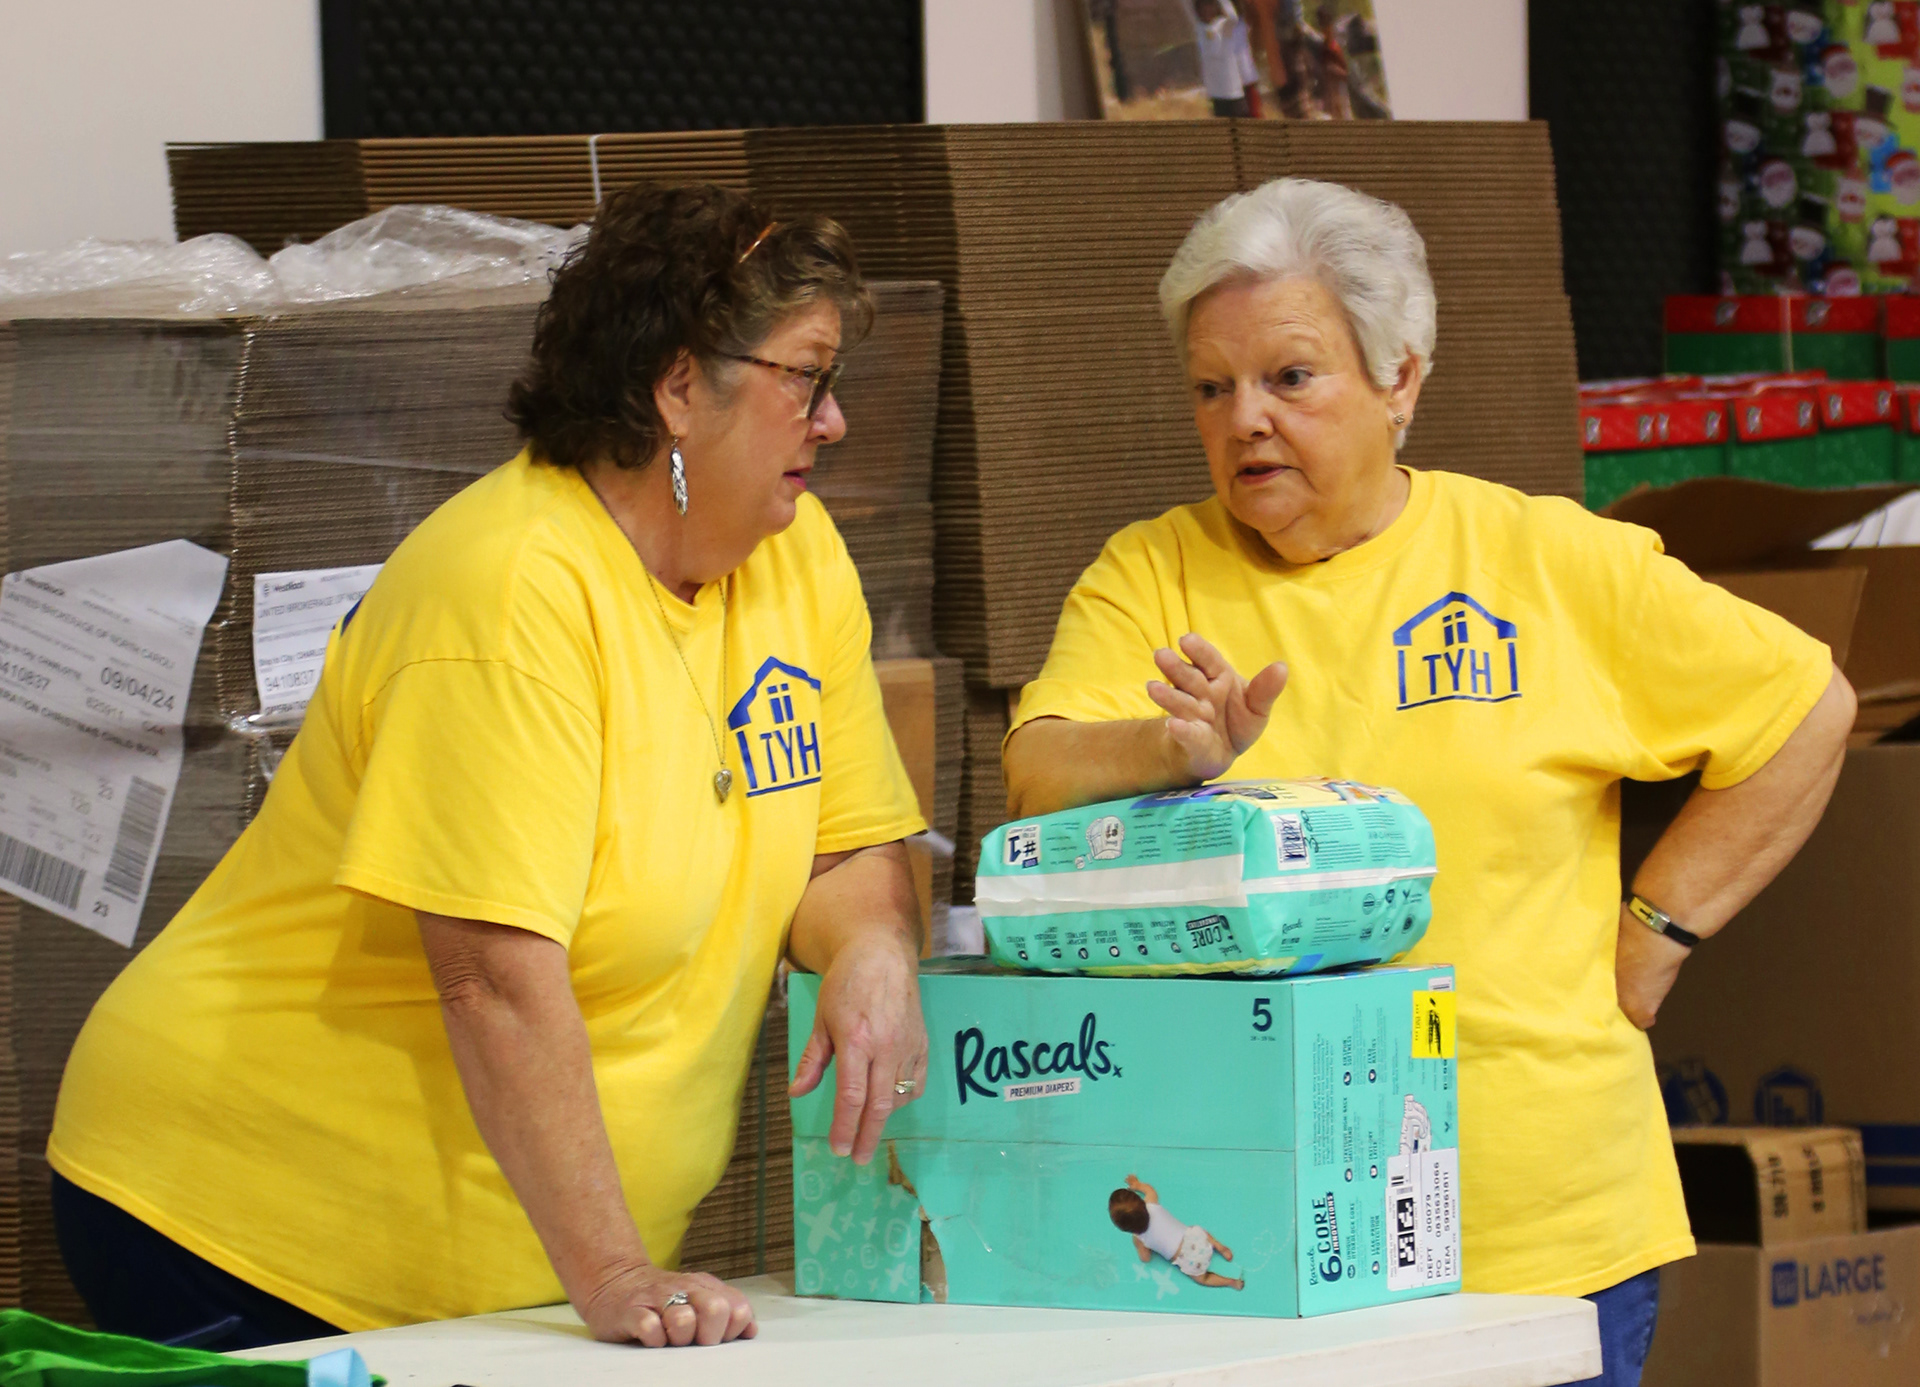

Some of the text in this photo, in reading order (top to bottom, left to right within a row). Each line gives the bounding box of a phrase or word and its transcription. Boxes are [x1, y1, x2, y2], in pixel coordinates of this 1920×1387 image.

[101, 667, 175, 712] 09/04/24
[1422, 648, 1492, 696] TYH
[759, 722, 821, 782] TYH
[1190, 925, 1222, 949] CORE
[1252, 997, 1273, 1033] 5
[954, 1012, 1111, 1106] Rascals
[1009, 1081, 1075, 1098] PREMIUM DIAPERS
[1312, 1197, 1342, 1283] 6 CORE
[1327, 1195, 1340, 1251] INNOVATIONS
[1436, 1260, 1442, 1278] PO
[1804, 1254, 1885, 1299] LARGE
